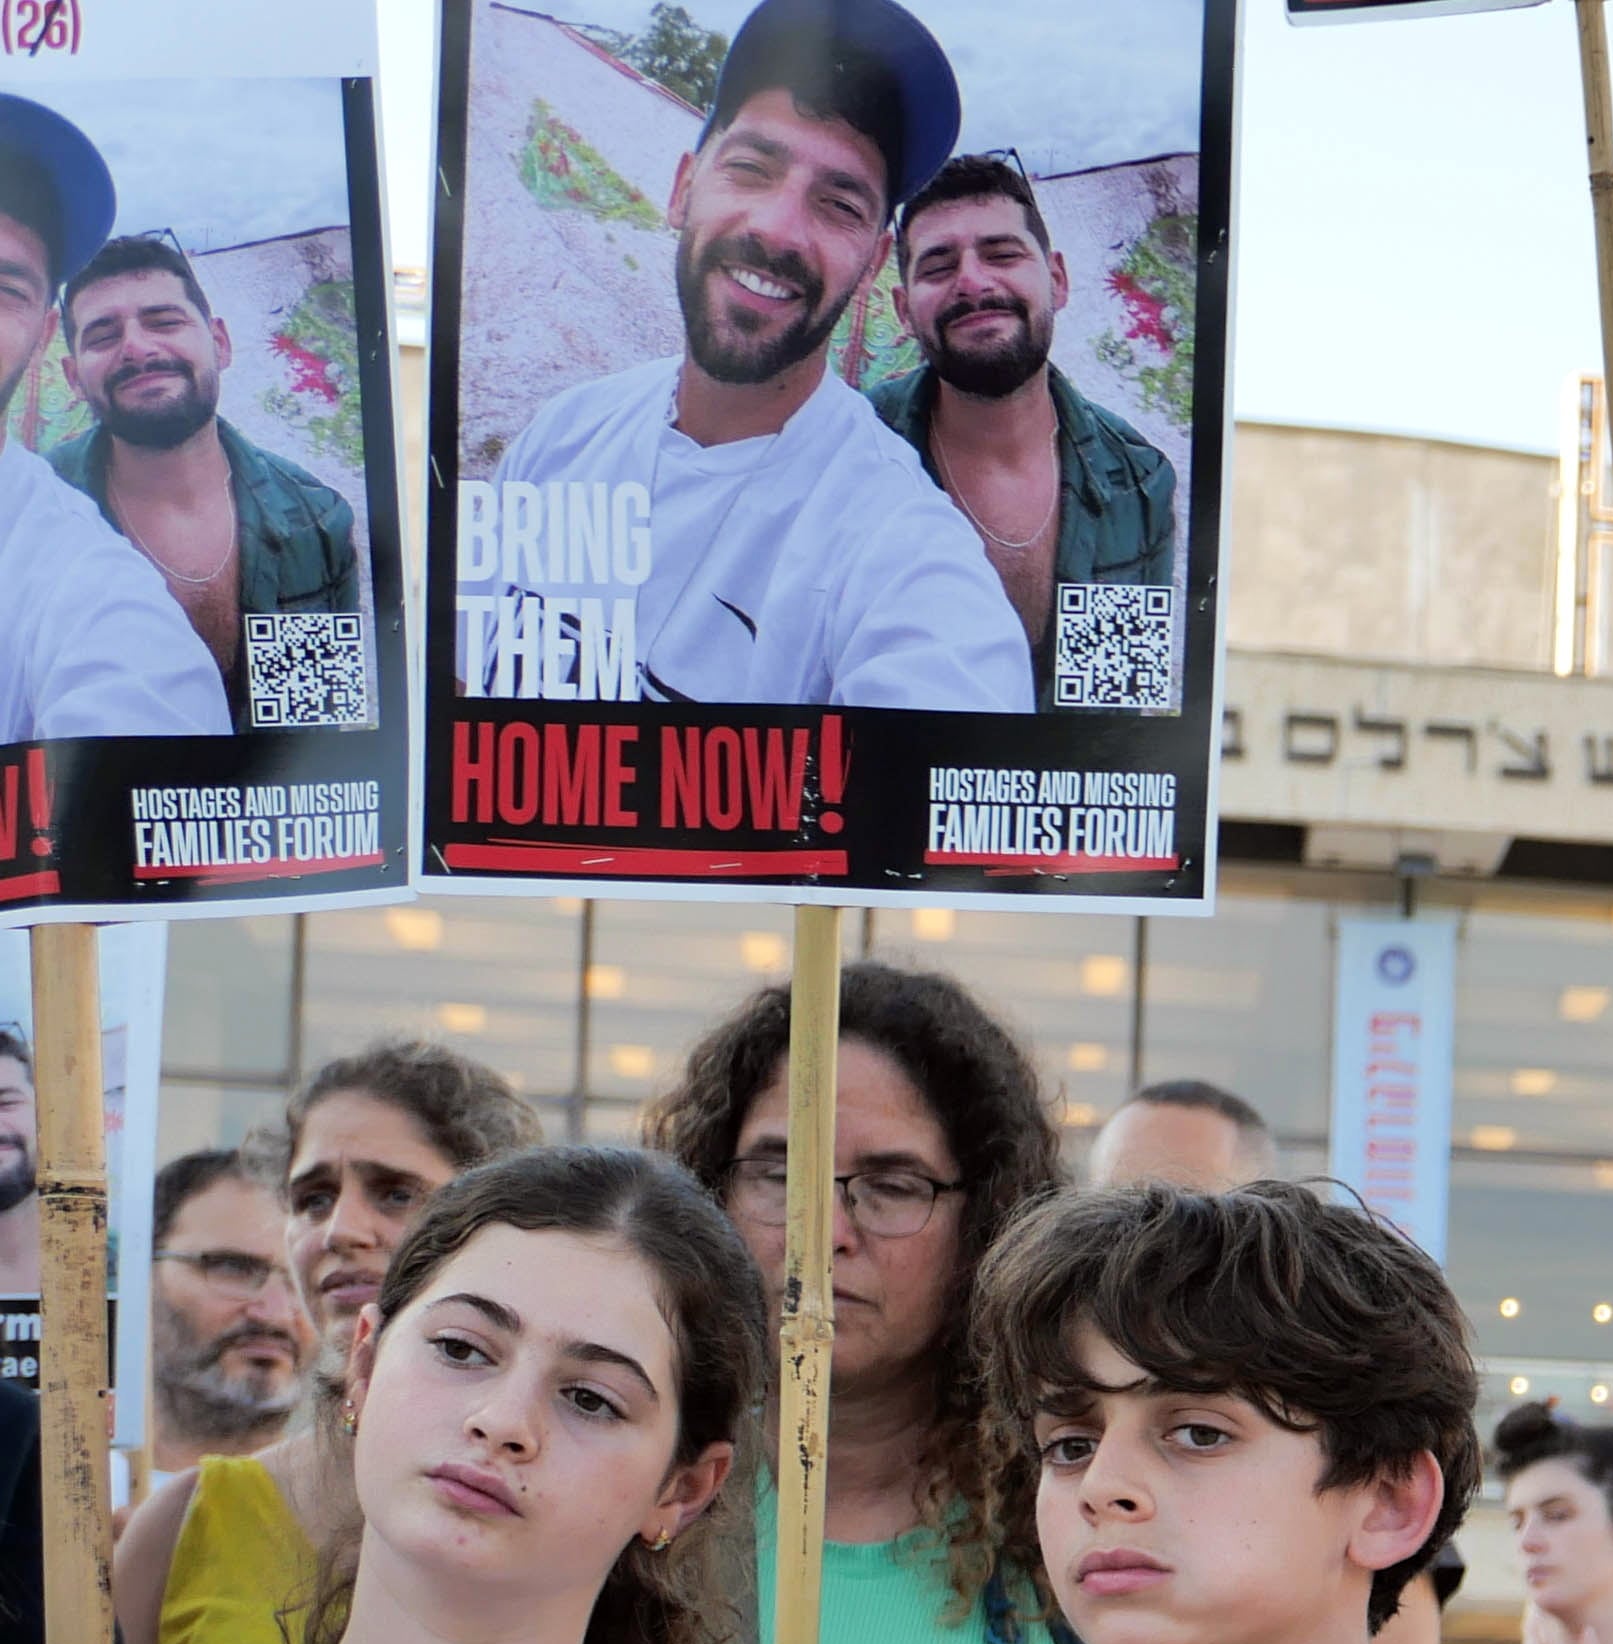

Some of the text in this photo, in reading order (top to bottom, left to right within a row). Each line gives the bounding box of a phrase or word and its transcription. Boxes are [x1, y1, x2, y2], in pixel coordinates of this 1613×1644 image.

[459, 481, 651, 585] BRING
[454, 594, 640, 702] THEM
[451, 714, 852, 832] HOME NOW!
[930, 767, 1175, 809] HOSTAGES AND MISSING
[131, 781, 379, 821] HOSTAGES AND MISSING
[135, 812, 380, 867] FAMILIES FORUM
[928, 804, 1175, 859] FAMILIES FORUM
